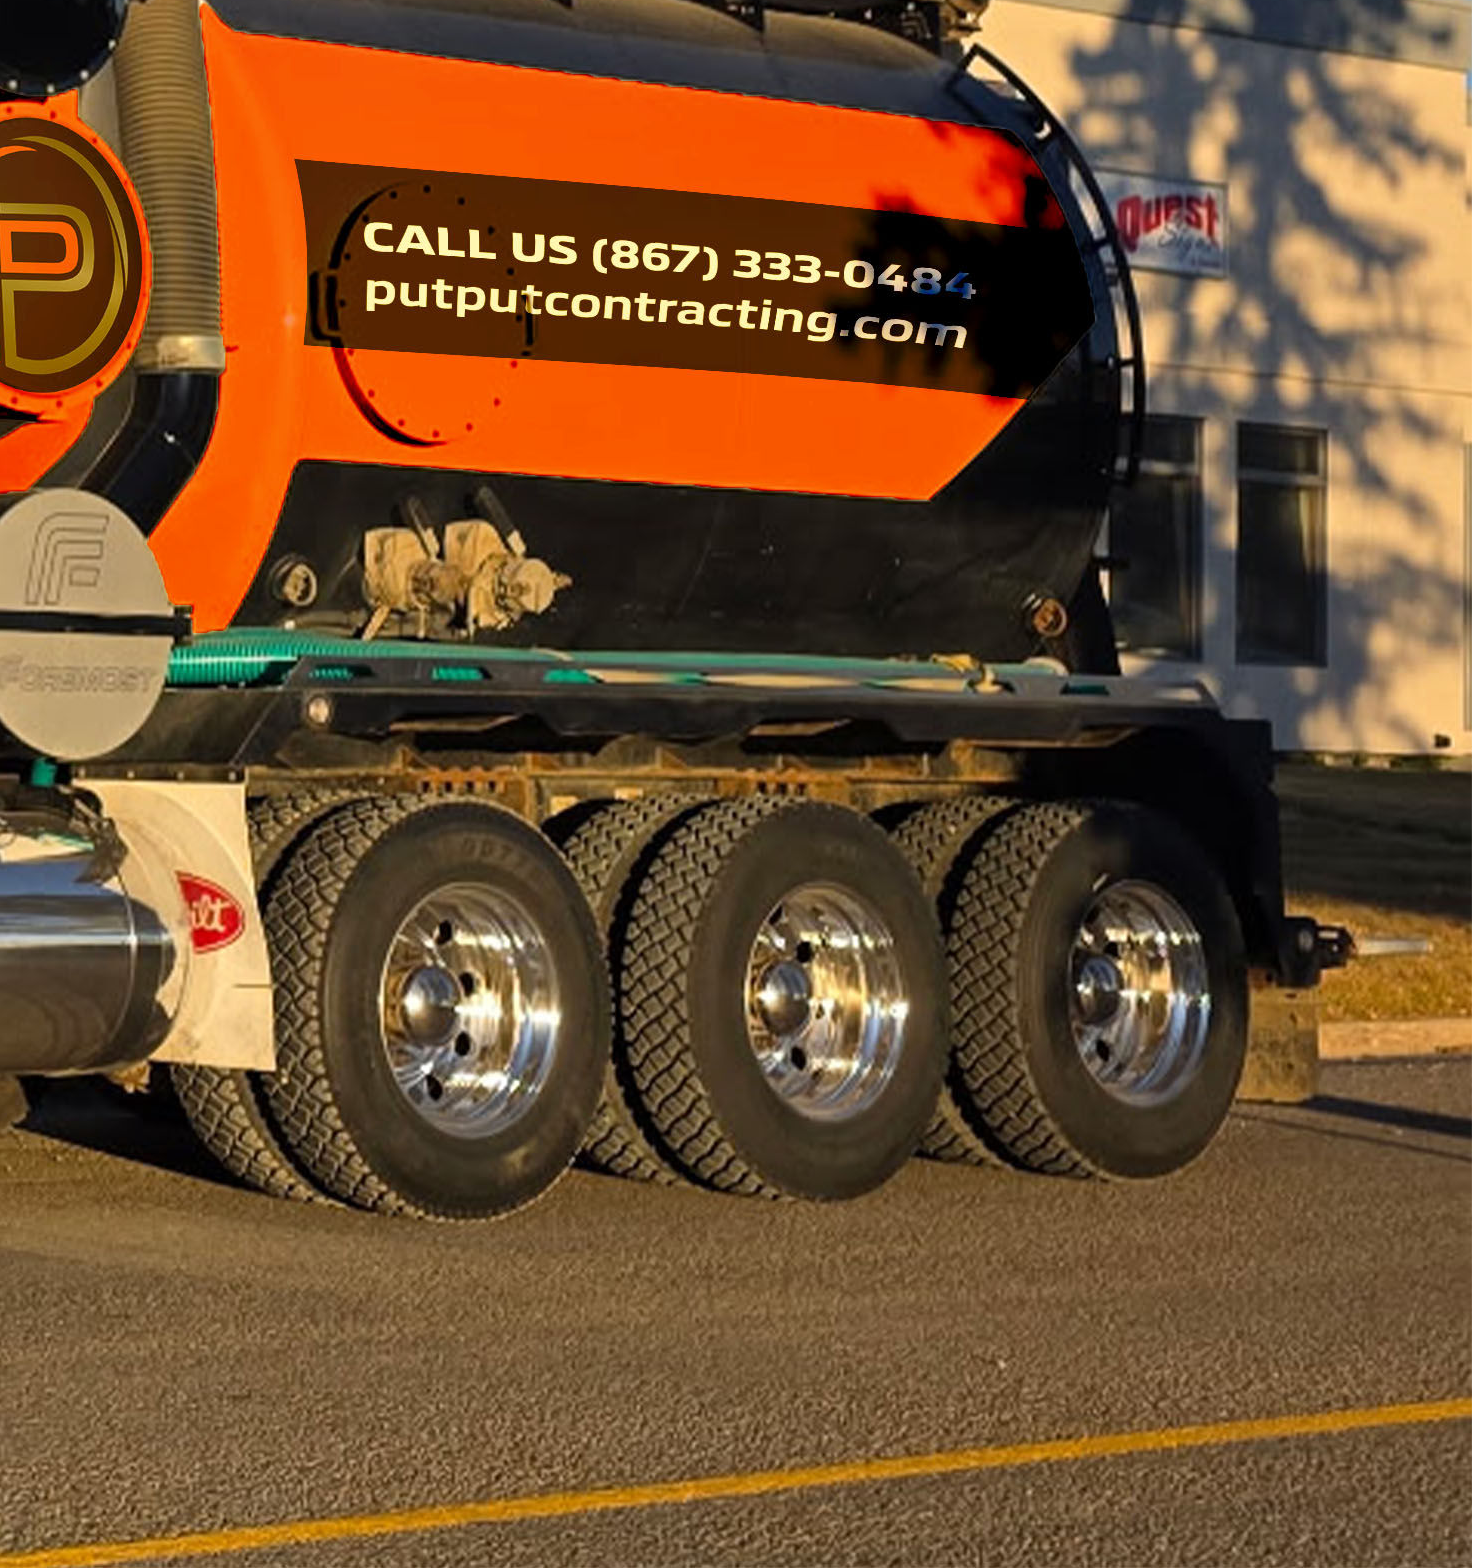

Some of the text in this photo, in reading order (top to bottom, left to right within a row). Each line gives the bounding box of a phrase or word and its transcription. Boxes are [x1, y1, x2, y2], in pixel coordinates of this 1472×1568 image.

[363, 221, 977, 300] CALL US (867) 333-0484
[365, 278, 968, 349] putputcontracting.com
